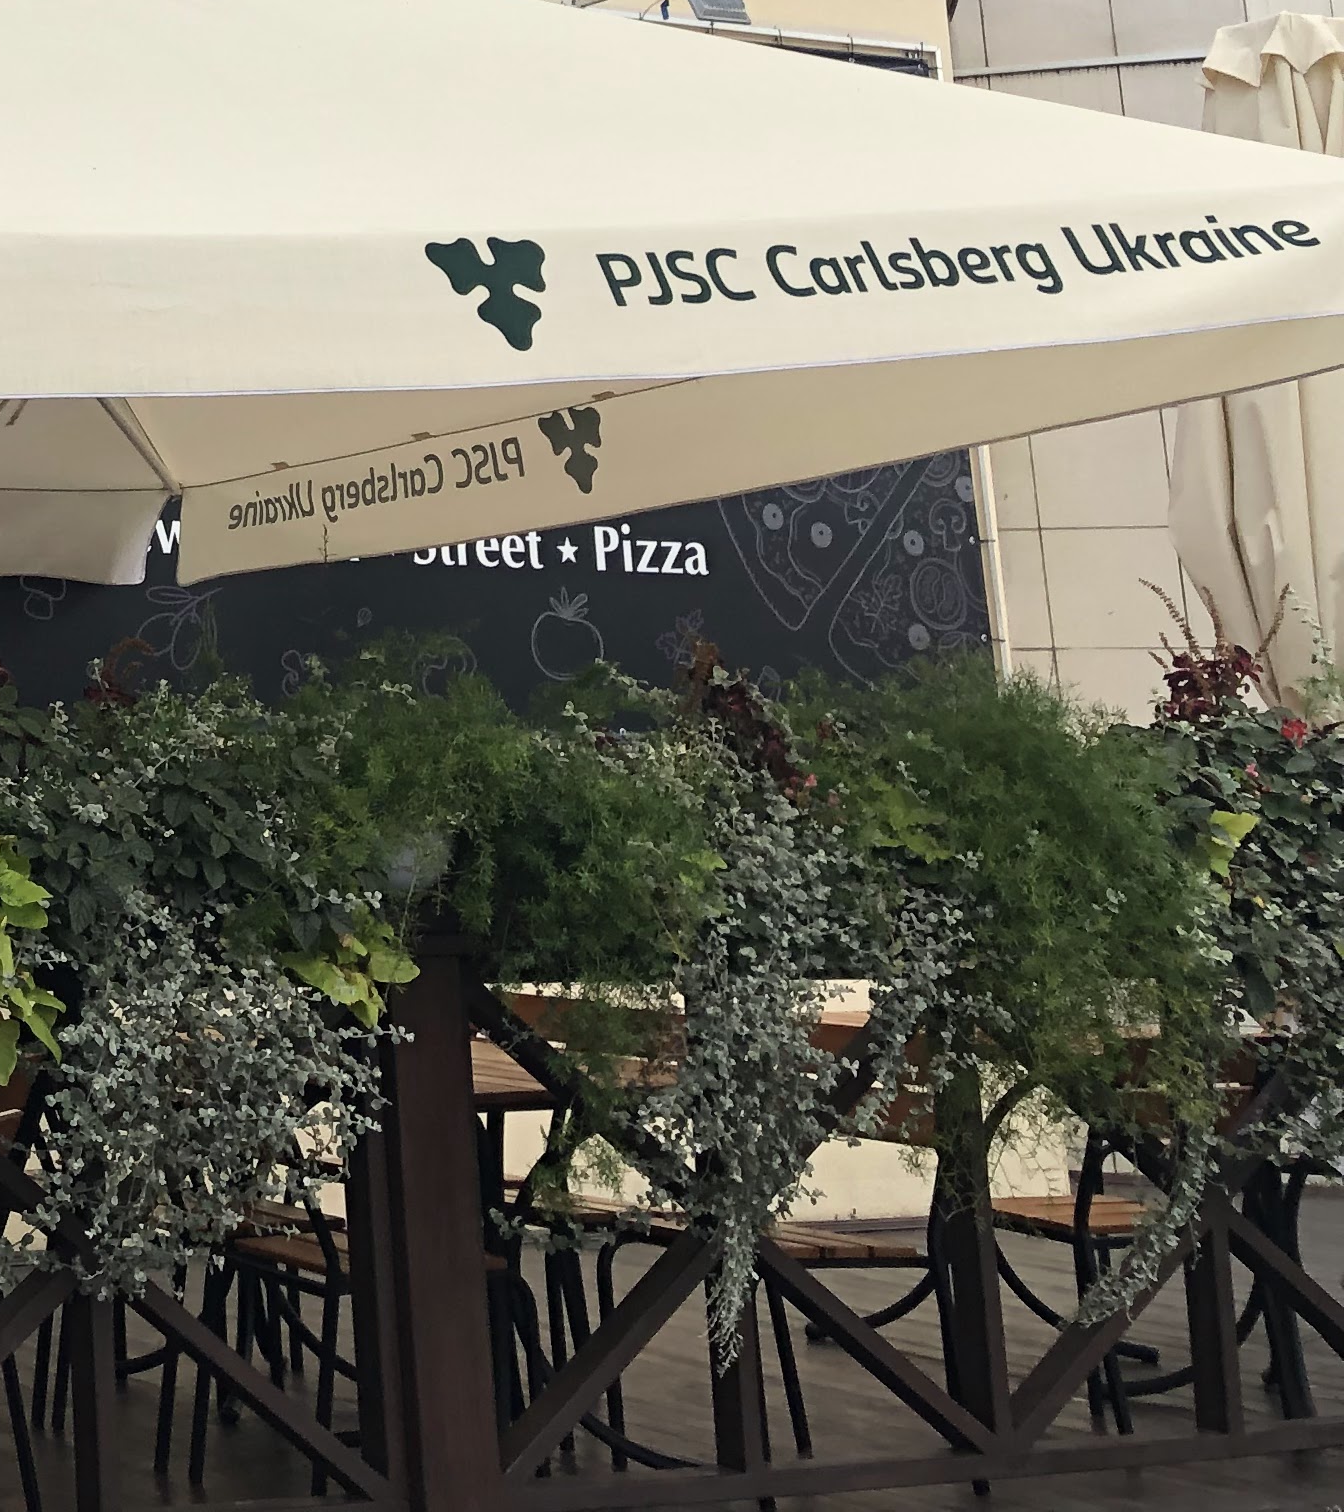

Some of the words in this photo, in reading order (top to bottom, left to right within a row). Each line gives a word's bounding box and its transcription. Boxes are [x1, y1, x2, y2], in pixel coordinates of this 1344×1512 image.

[595, 248, 757, 307] PJSC
[765, 237, 1064, 298] Carlsberg
[1059, 215, 1322, 276] Ukraine
[592, 522, 710, 577] Pizza
